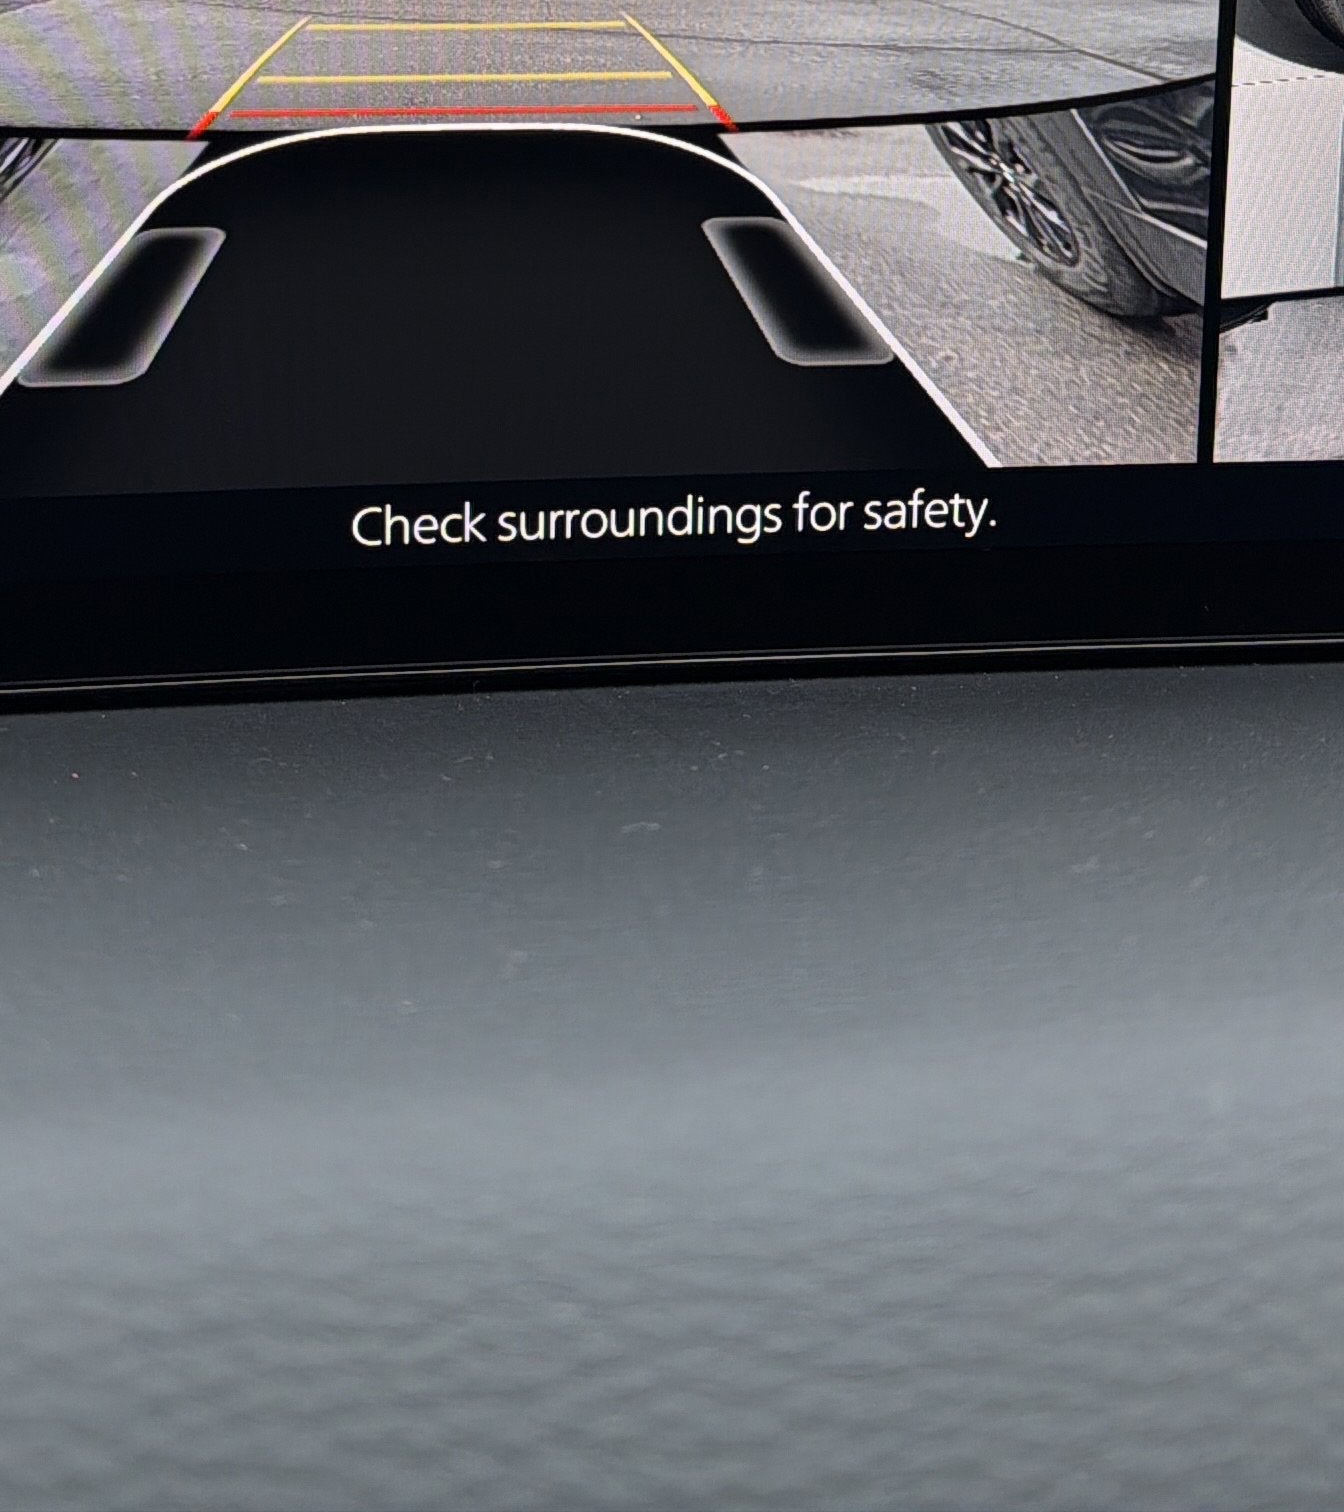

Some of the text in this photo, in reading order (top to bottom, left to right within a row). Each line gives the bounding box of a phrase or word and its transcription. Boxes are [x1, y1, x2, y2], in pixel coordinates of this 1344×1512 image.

[353, 487, 997, 547] Check surroundings for safety.
